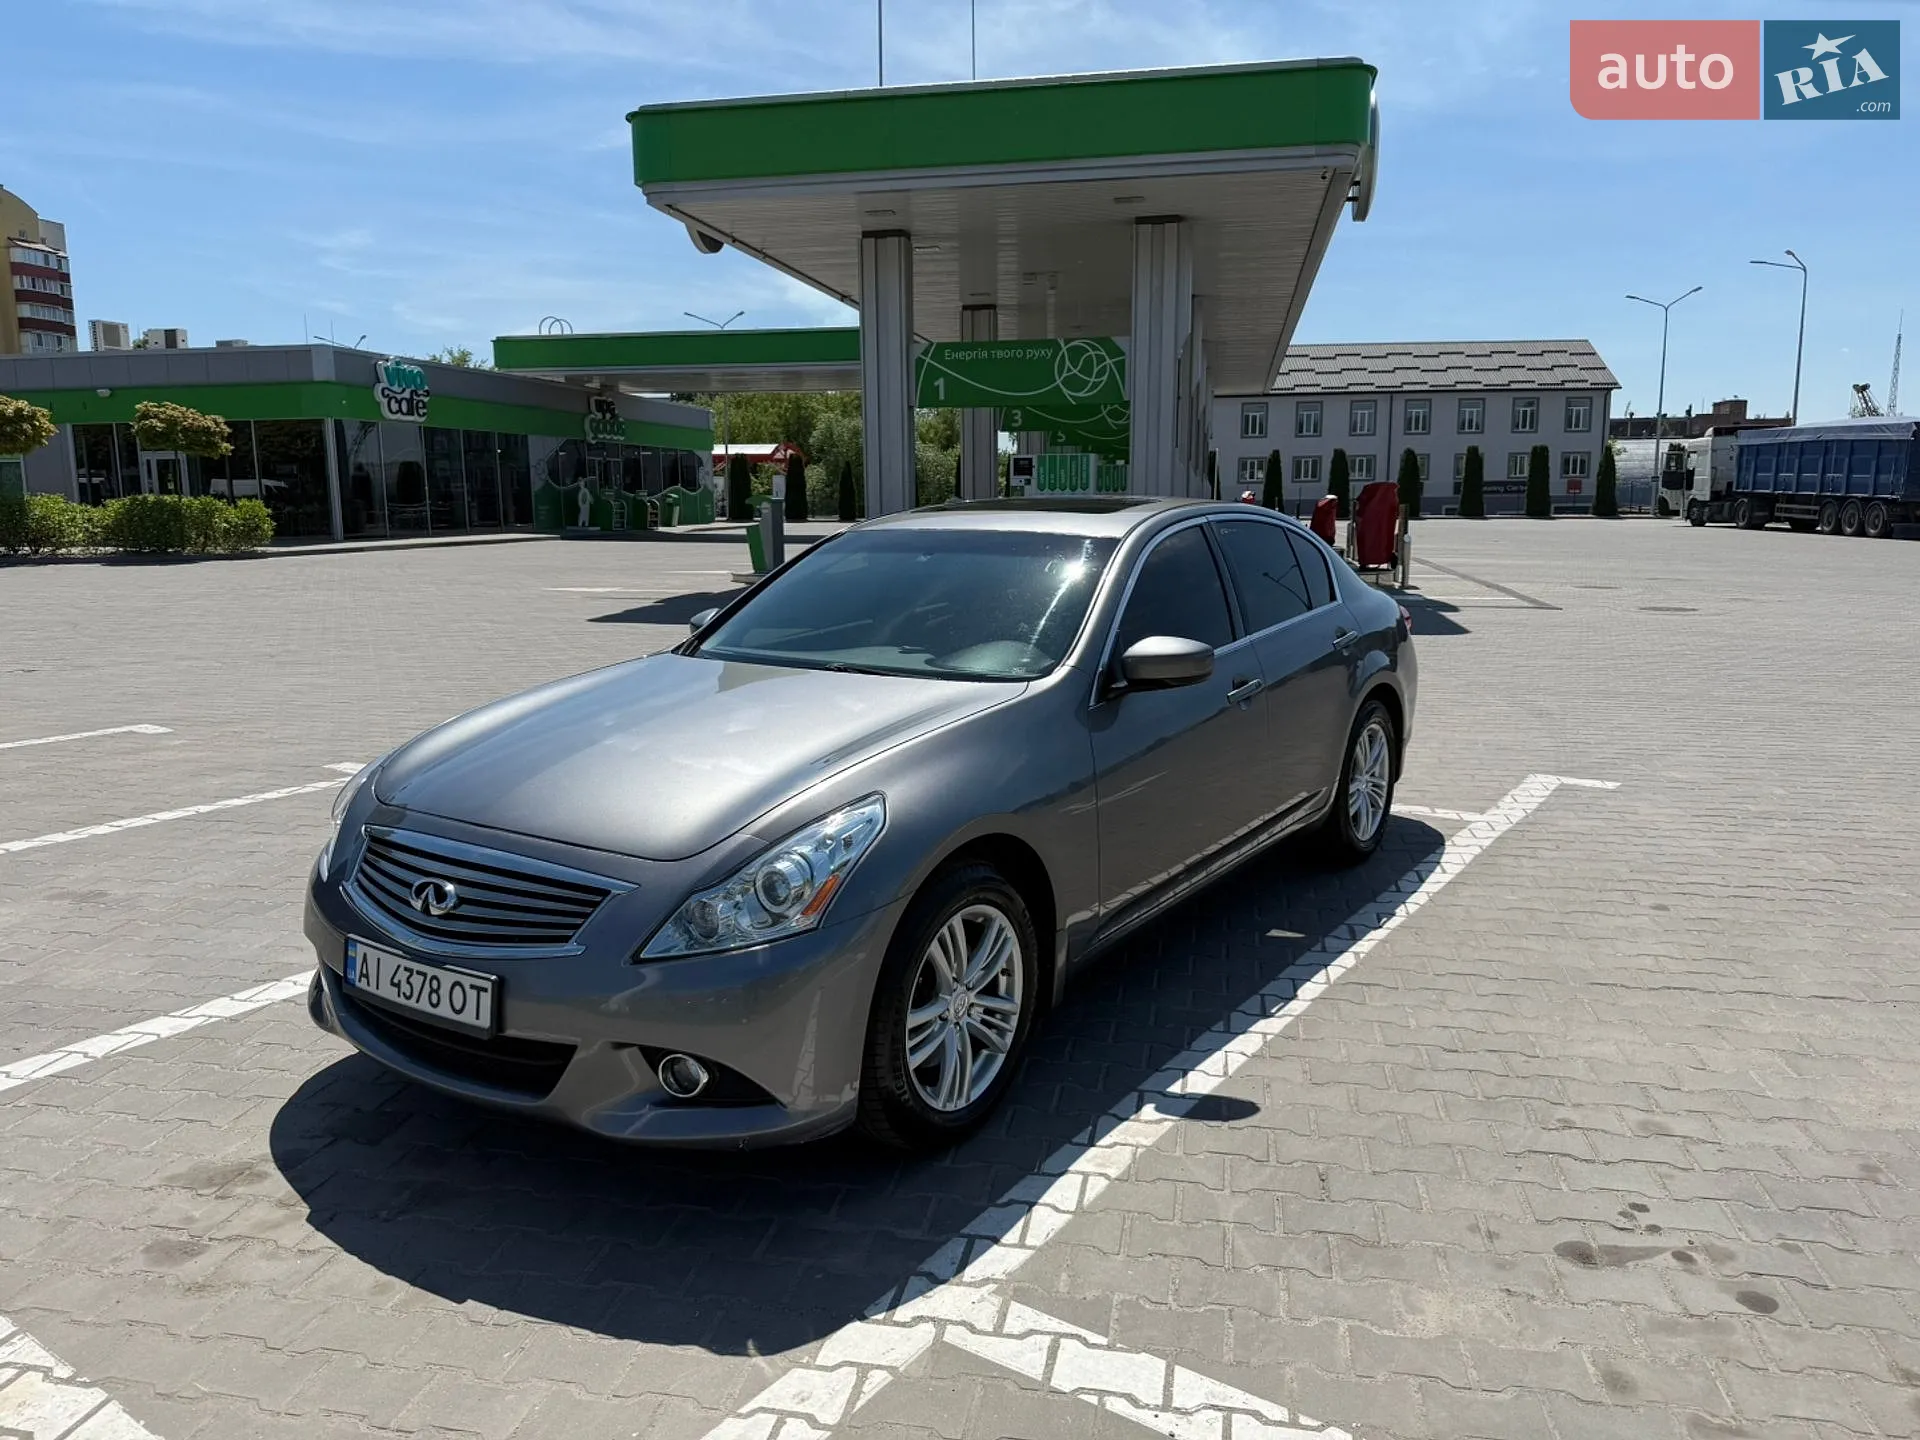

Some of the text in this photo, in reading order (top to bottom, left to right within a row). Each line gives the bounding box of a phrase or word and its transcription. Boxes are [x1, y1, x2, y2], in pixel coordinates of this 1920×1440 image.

[944, 347, 1053, 361] Енергія твого руху
[934, 377, 945, 400] 1
[1011, 409, 1023, 427] 3
[358, 952, 488, 1021] AI 4378 OT
